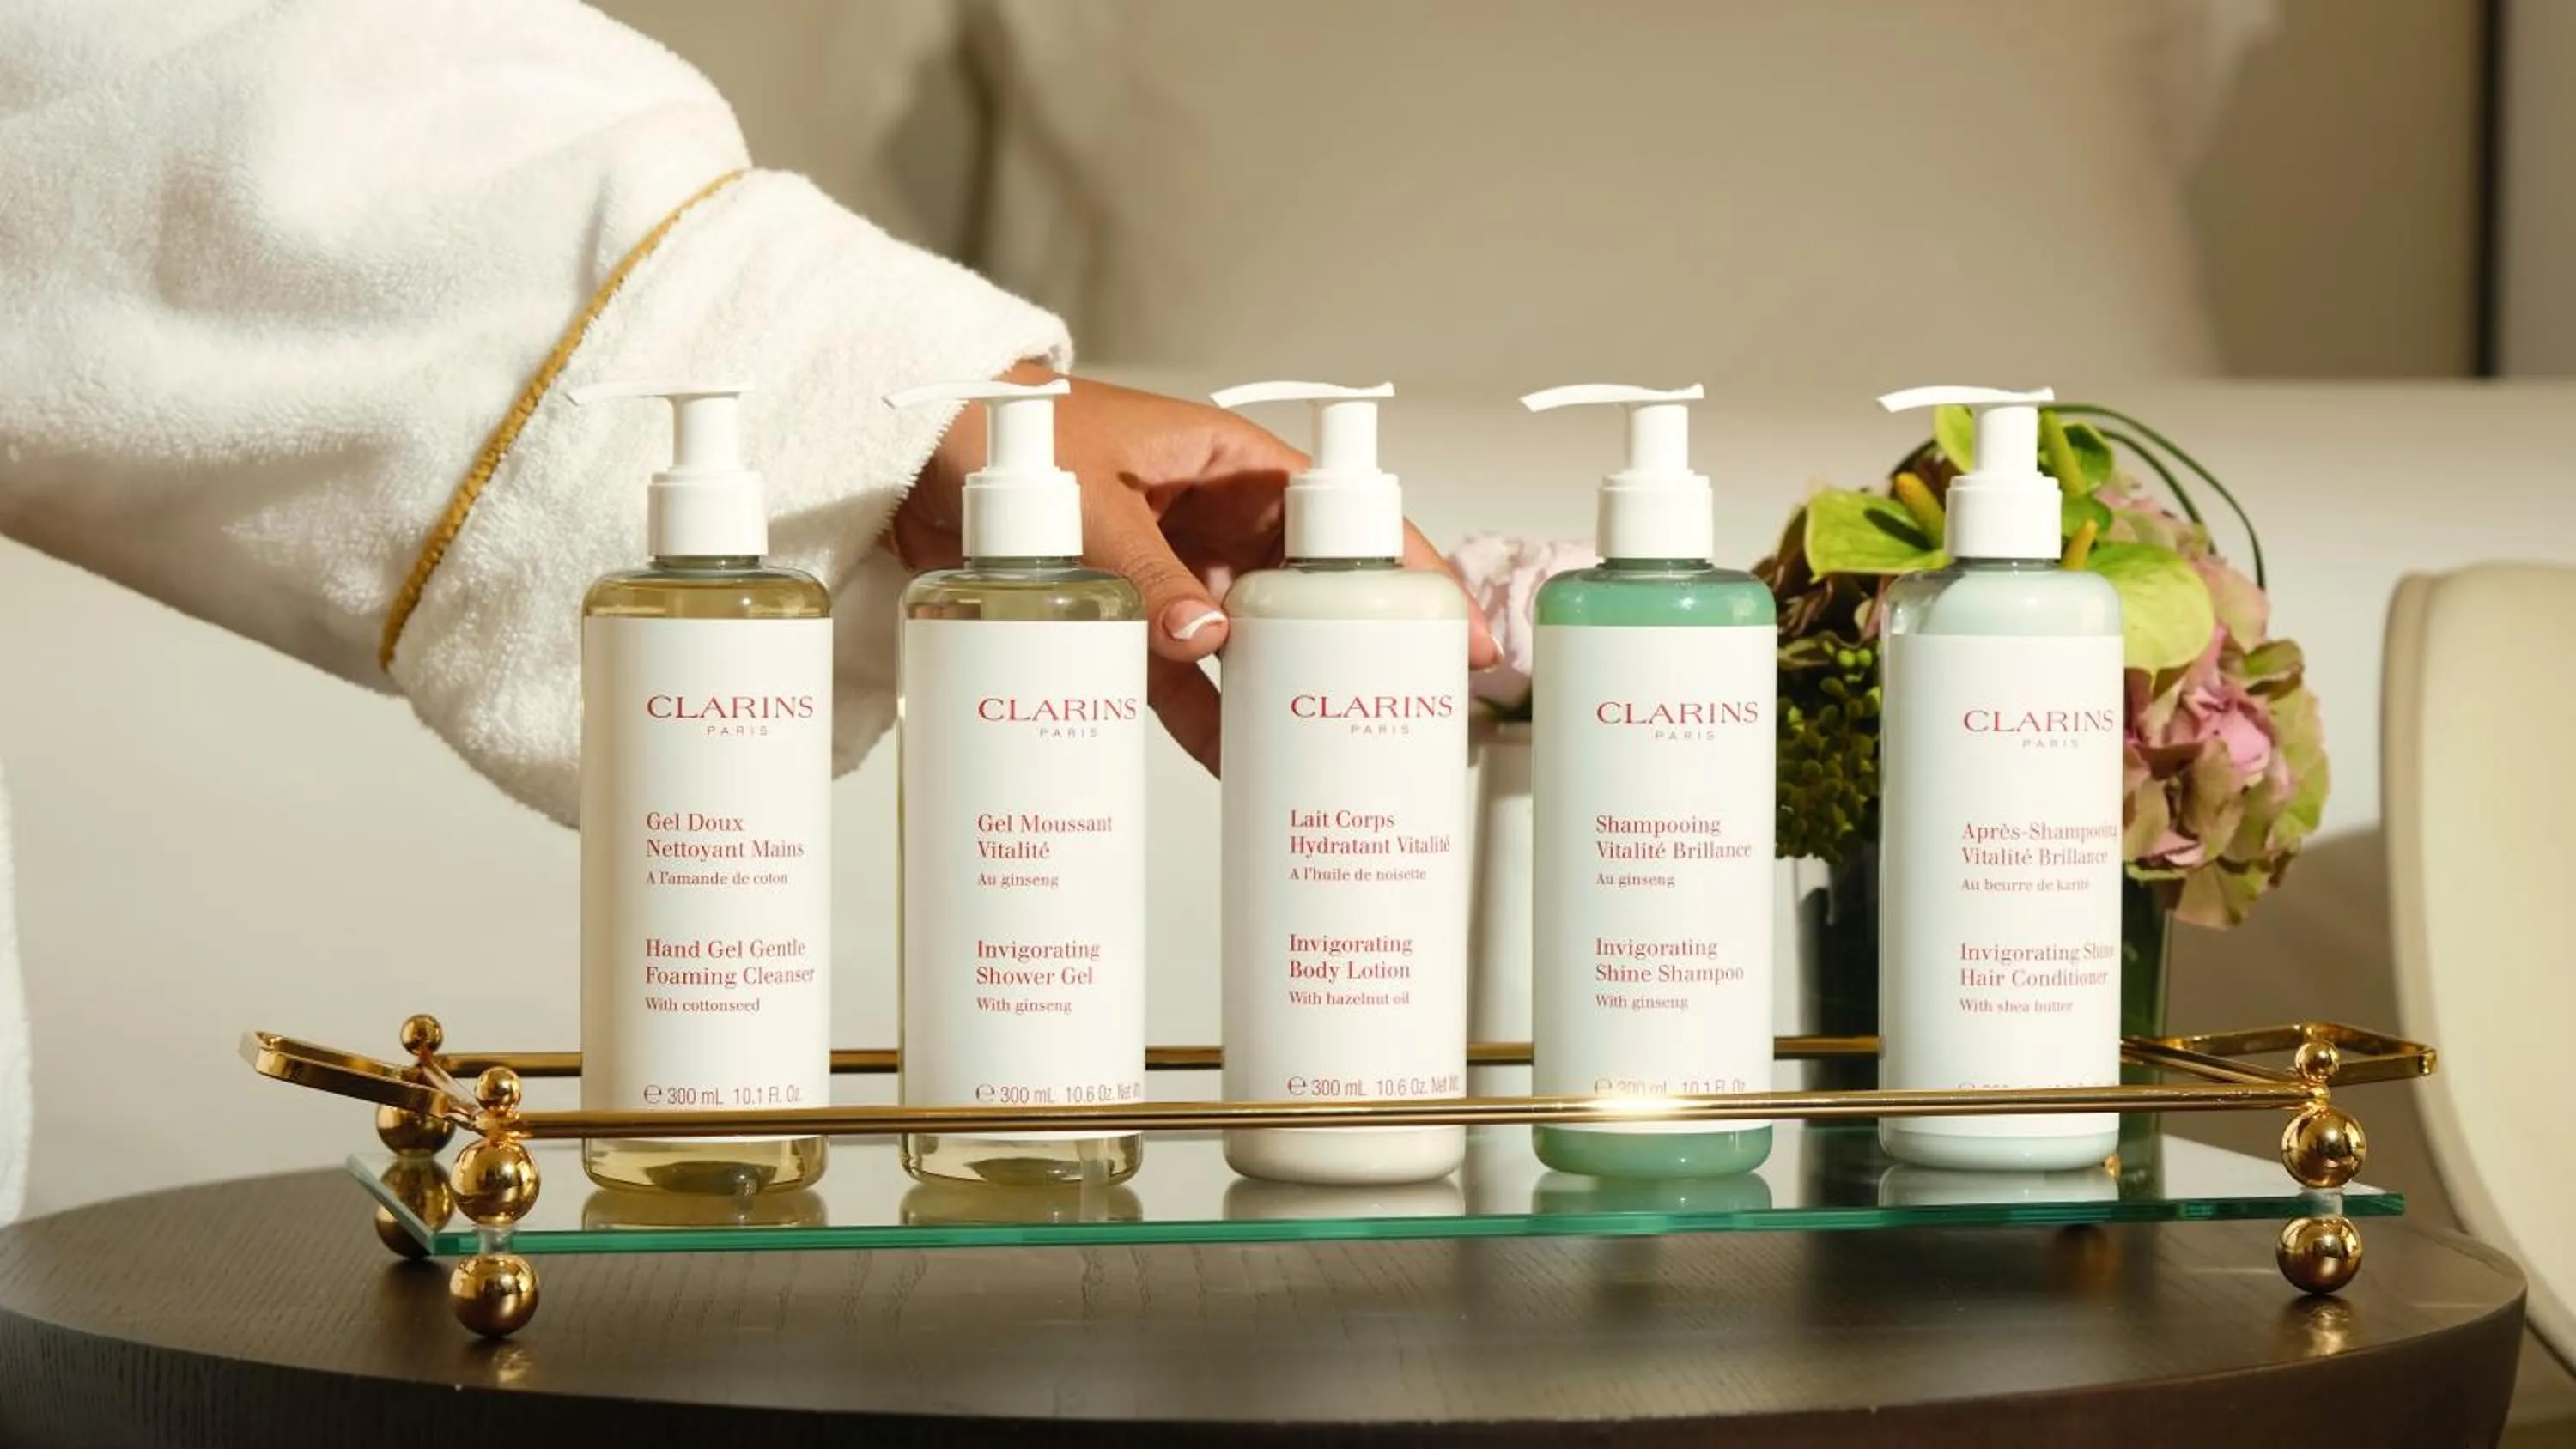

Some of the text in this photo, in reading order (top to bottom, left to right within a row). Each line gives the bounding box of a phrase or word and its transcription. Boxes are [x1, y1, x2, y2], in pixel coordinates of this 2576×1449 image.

[647, 695, 814, 719] CLARINS
[978, 698, 1137, 721] CLARINS
[1291, 694, 1453, 718] CLARINS
[1596, 702, 1759, 724] CLARINS
[1351, 725, 1410, 734] PARIS
[1963, 710, 2114, 732] CLARINS
[707, 726, 768, 736] PARIS
[1039, 728, 1098, 737] PARIS
[1655, 731, 1715, 740] PARIS
[2022, 739, 2078, 748] PARIS
[647, 812, 744, 831] Gel Doux
[977, 814, 1112, 833] Gel Moussant
[1291, 809, 1395, 833] Lait Corps
[1595, 815, 1721, 838] Shampooing
[646, 839, 805, 862] Nettoyant Mains
[977, 840, 1050, 859] Vitalité
[1290, 834, 1450, 858] Hydratant Vitalité
[1596, 840, 1752, 859] Vitalité Brillance
[1962, 847, 2108, 865] Vitalité Brillance
[647, 871, 788, 885] A l'amande de coton
[978, 873, 1059, 889] Au ginseng
[1290, 867, 1426, 881] A l'huile de noisette
[1596, 873, 1675, 888] Au ginseng
[1962, 879, 1979, 892] Au
[1984, 878, 2032, 892] beurre
[2037, 879, 2053, 891] de
[646, 938, 806, 958] Hand Gel Gentle
[977, 940, 1100, 962] Invigorating
[1290, 934, 1413, 956] Invigorating
[1595, 937, 1718, 960] Invigorating
[1960, 943, 2080, 966] Invigorating
[646, 966, 815, 989] Foaming Cleanser
[976, 967, 1093, 985] Shower Gel
[1290, 961, 1411, 983] Body Lotion
[1595, 963, 1744, 985] Shine Shampoo
[1960, 968, 2108, 987] Hair Conditioner
[646, 997, 761, 1012] With cottonseed
[976, 997, 1072, 1015] With ginseng
[1290, 991, 1410, 1005] With hazelnut oil
[1595, 994, 1688, 1011] With ginseng
[1959, 998, 2073, 1013] With shea butter
[667, 1088, 696, 1105] 300
[702, 1088, 724, 1105] mL
[733, 1087, 762, 1105] 10.1
[1000, 1087, 1030, 1104] 300
[1034, 1087, 1055, 1104] mL
[1066, 1085, 1095, 1103] 10.6
[1311, 1079, 1340, 1096] 300
[1345, 1079, 1367, 1096] mL
[1376, 1078, 1407, 1096] 10.6
[1682, 1079, 1710, 1094] 101
